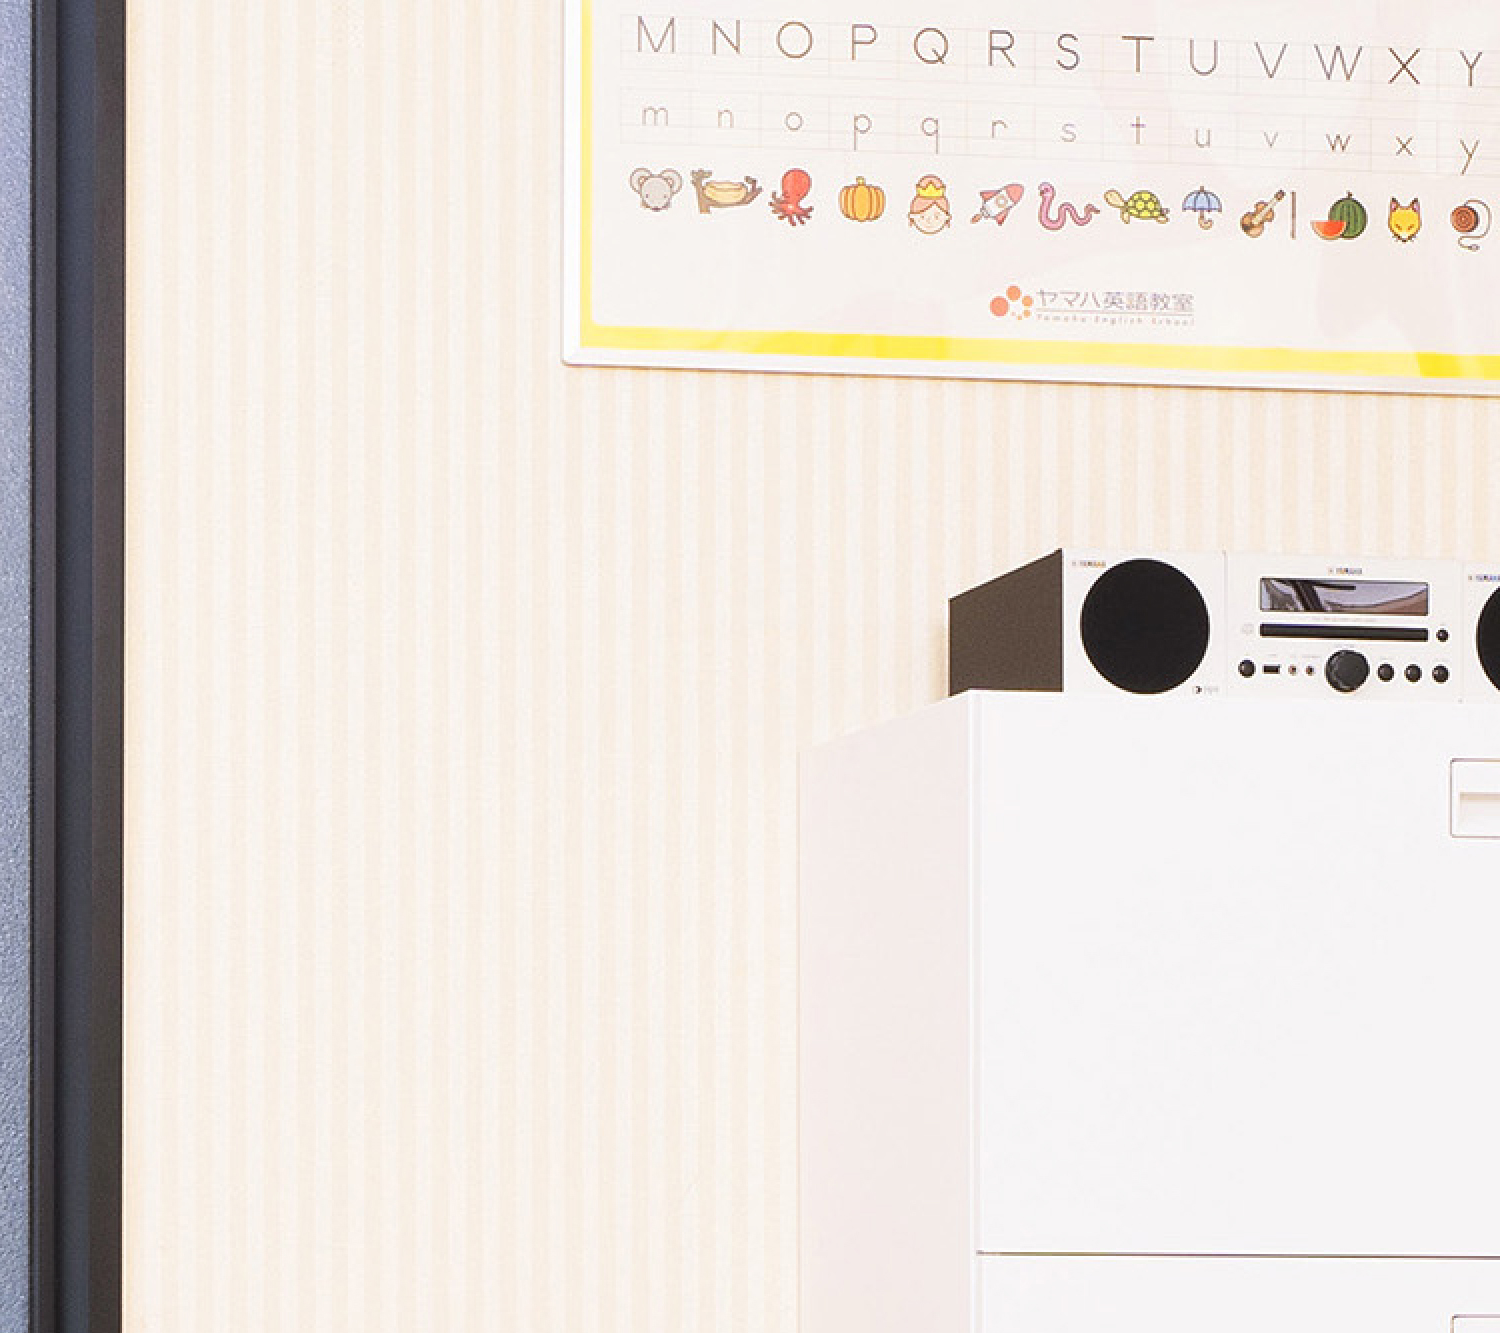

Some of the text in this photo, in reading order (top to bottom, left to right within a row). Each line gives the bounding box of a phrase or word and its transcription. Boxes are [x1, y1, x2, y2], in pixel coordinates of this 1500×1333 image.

[637, 15, 1483, 87] M N O P Q R S T U V W X Y
[642, 107, 1480, 176] m n o p q r s t u v w x y
